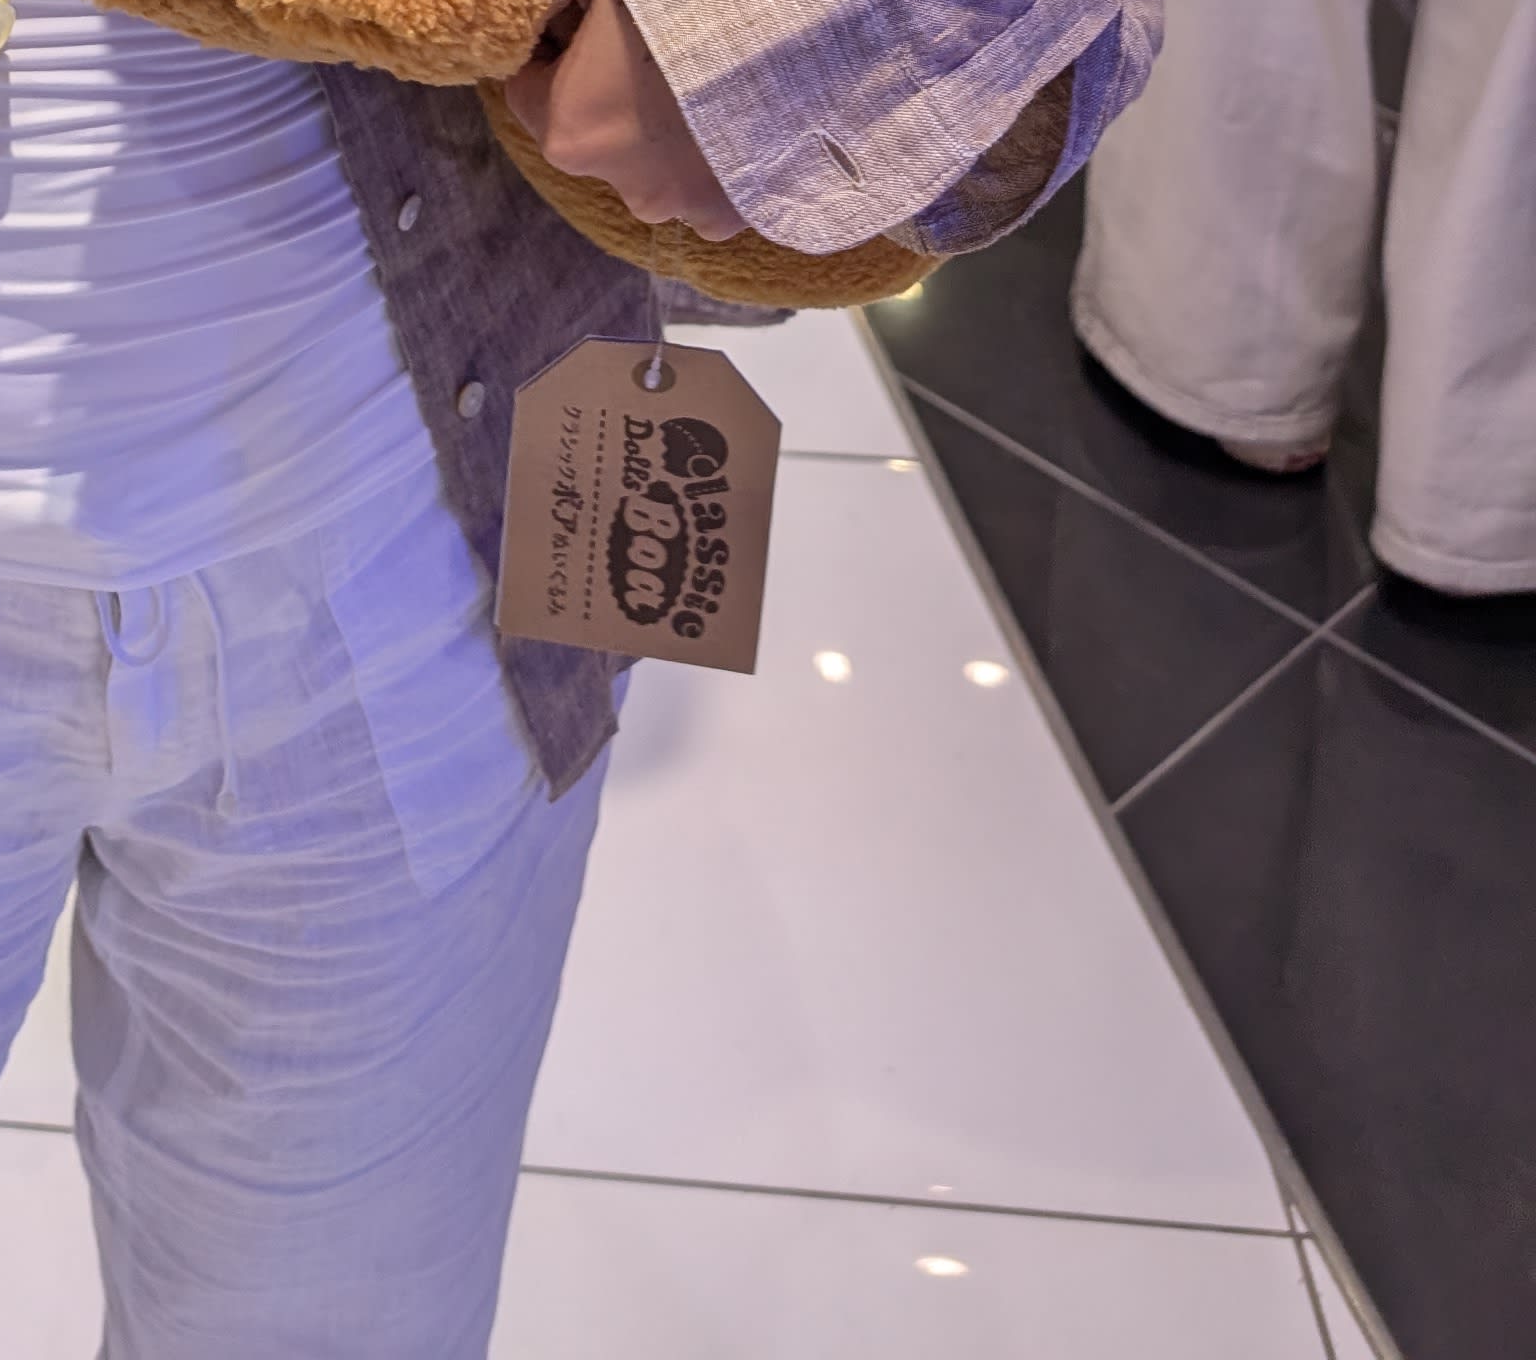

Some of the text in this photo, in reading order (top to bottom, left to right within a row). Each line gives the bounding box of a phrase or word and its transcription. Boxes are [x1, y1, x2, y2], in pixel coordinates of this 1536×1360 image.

[623, 414, 654, 492] Dolls
[623, 495, 681, 611] Boa
[671, 453, 731, 639] Classic
